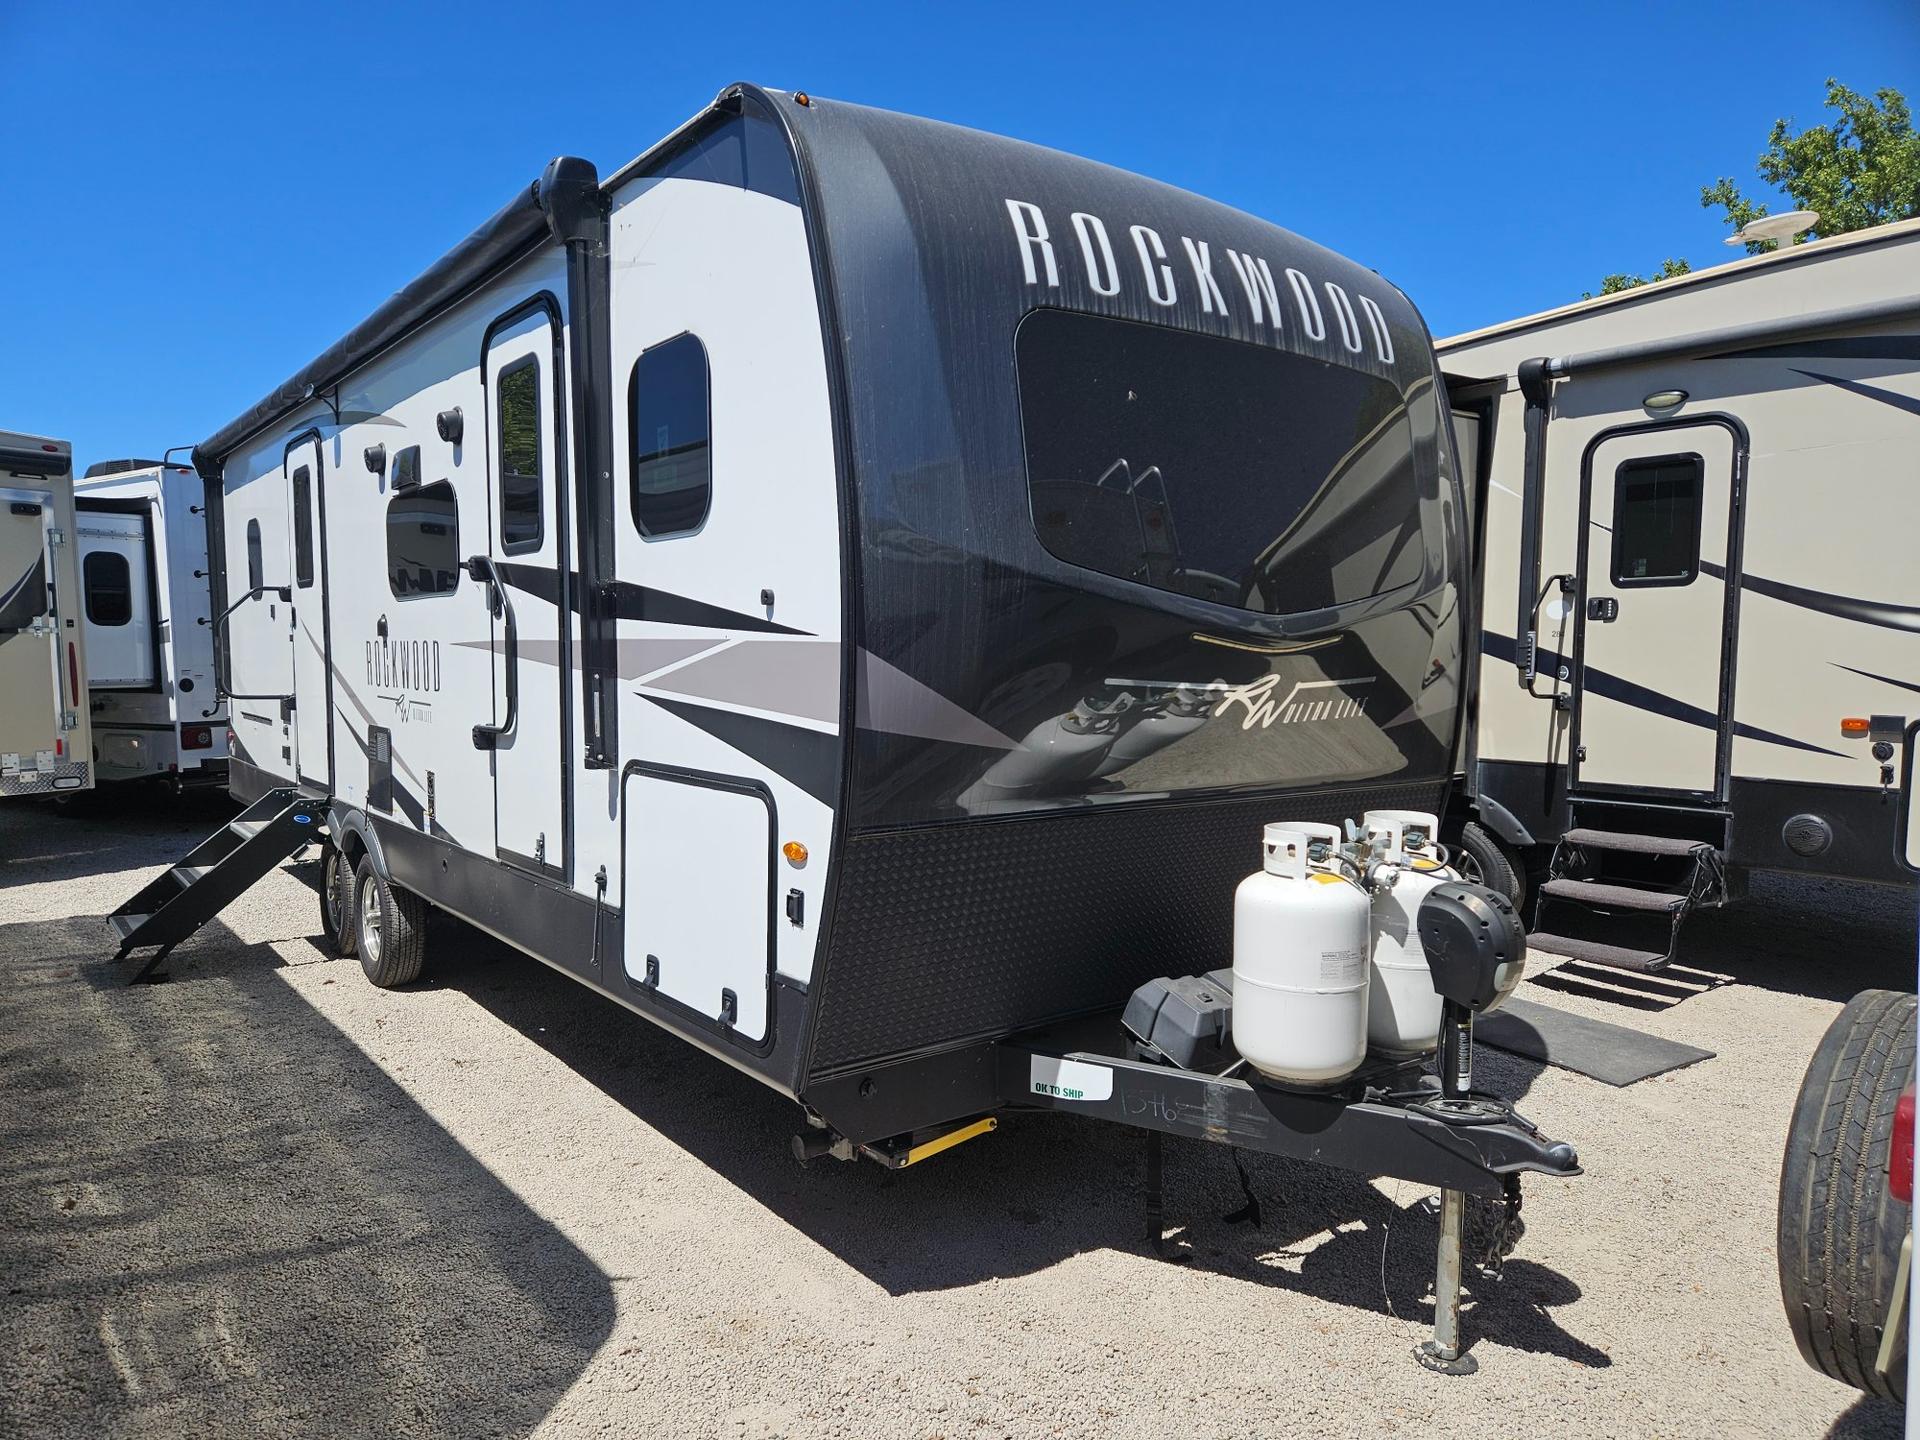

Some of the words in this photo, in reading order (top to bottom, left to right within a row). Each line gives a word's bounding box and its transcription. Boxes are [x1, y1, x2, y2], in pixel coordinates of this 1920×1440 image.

[1004, 198, 1395, 364] ROCKWOOD
[365, 639, 441, 692] ROCKWOOD
[1035, 1082, 1048, 1093] OK
[1049, 1085, 1061, 1096] TO
[1062, 1087, 1084, 1099] SHIP
